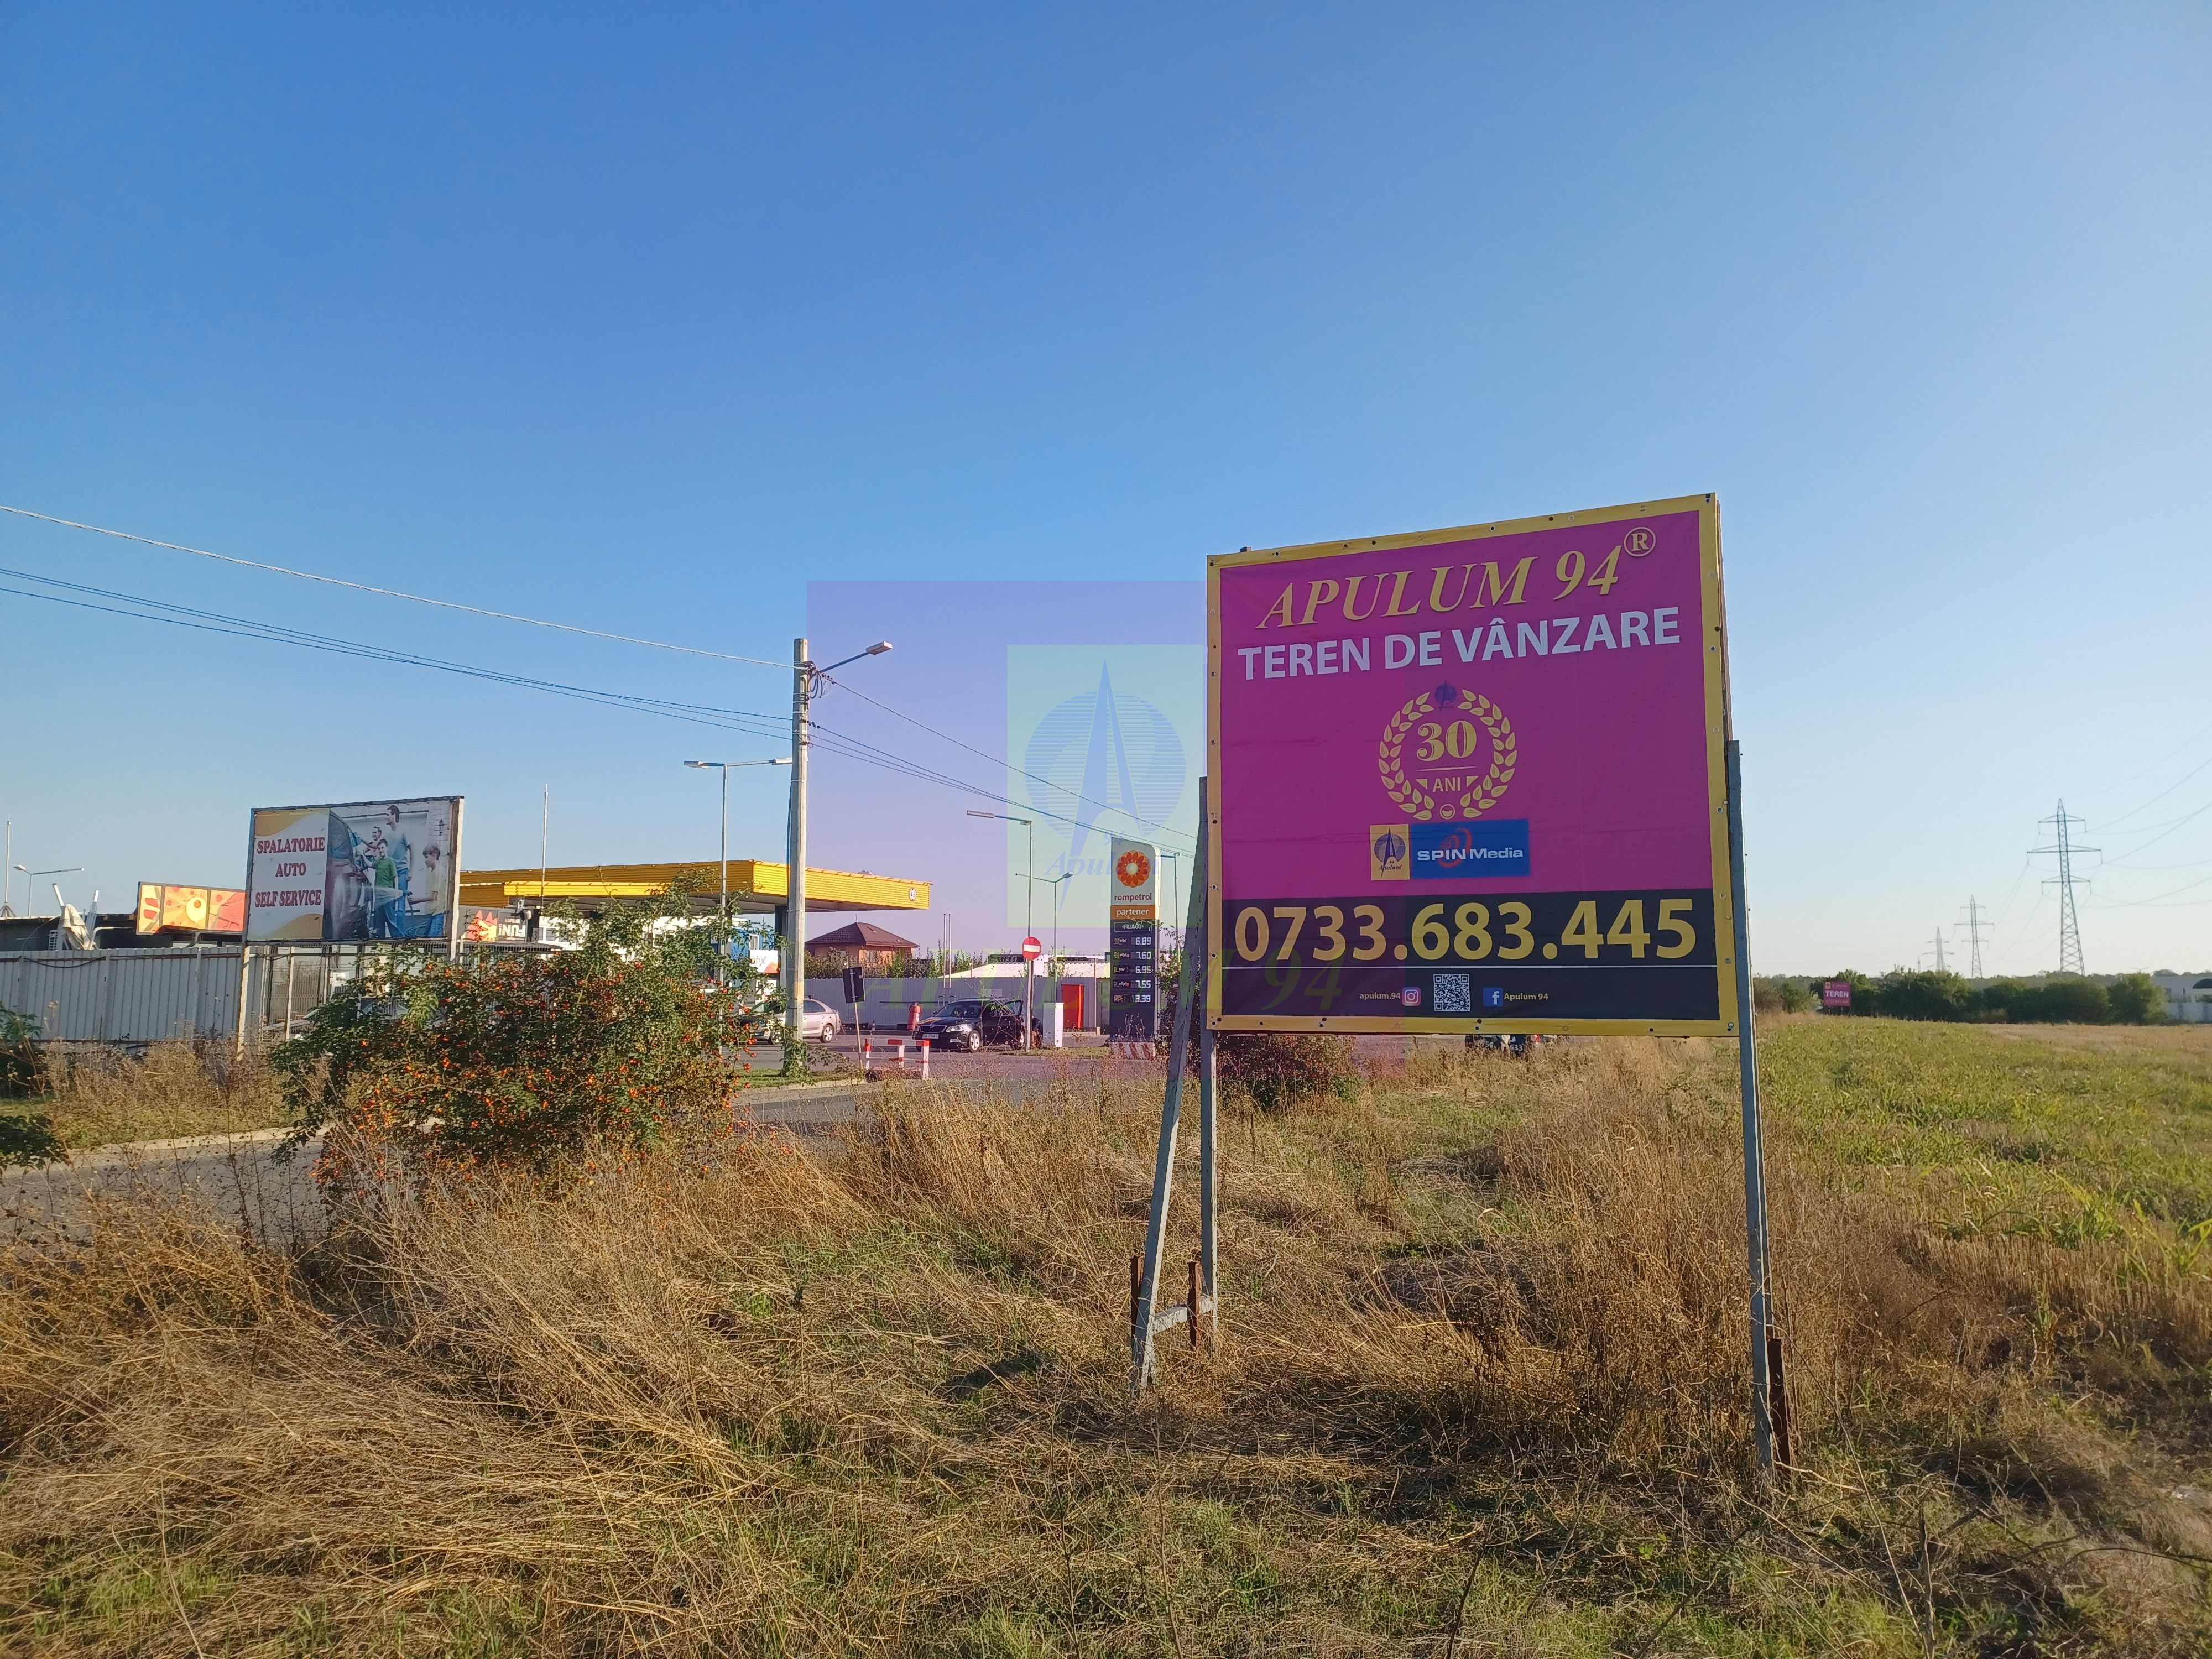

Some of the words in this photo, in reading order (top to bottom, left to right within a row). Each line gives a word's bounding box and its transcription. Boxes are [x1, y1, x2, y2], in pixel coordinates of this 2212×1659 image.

[1255, 555, 1538, 630] APULUM
[1238, 638, 1371, 681] TEREN
[1385, 631, 1442, 670] DE
[1452, 607, 1681, 662] VÂNZARE
[1416, 720, 1477, 761] 30
[1432, 776, 1460, 792] ANI
[257, 837, 325, 854] SPALATORIE
[275, 862, 306, 878] AUTO
[255, 891, 278, 907] SELF
[279, 889, 322, 906] SERVICE
[1114, 892, 1152, 902] rompetrol
[1117, 909, 1149, 917] partener
[1235, 899, 1696, 962] 0733.683.445
[1135, 937, 1151, 945] 6.89
[1135, 951, 1151, 959] 7.60
[1135, 966, 1151, 974] 6.95
[1135, 980, 1151, 988] 7.55
